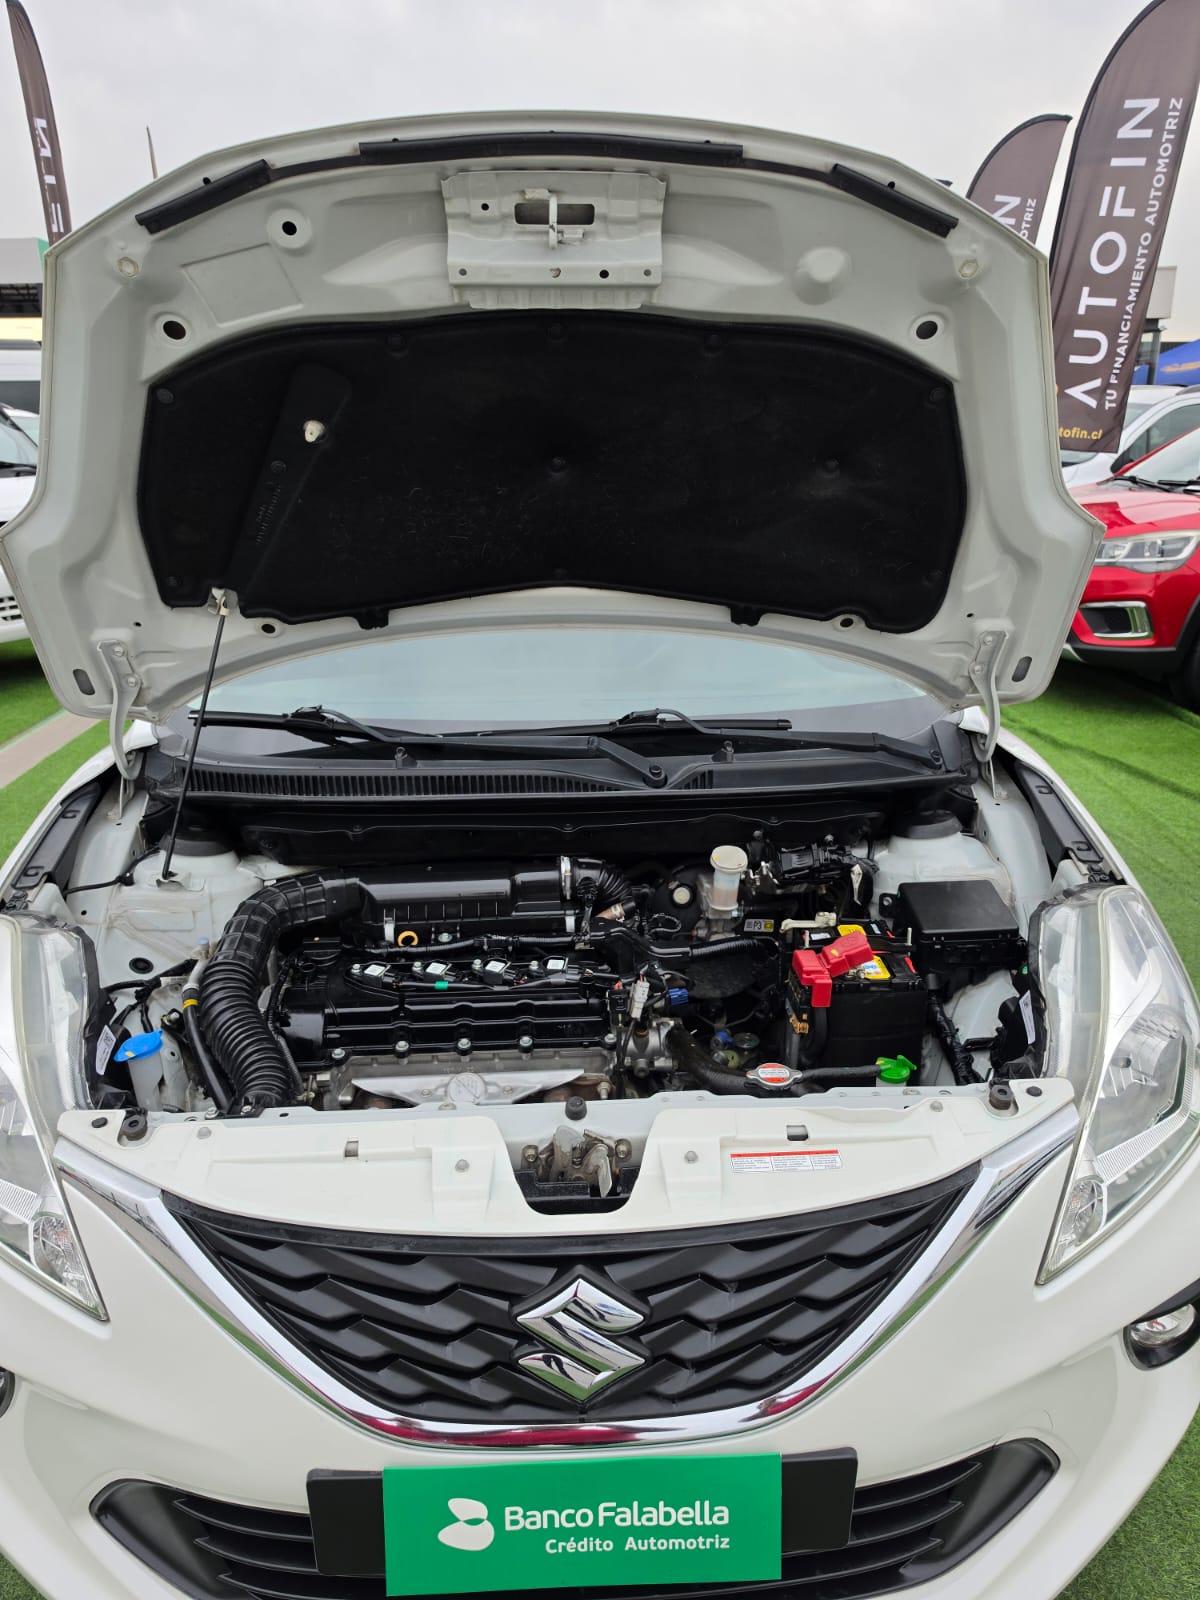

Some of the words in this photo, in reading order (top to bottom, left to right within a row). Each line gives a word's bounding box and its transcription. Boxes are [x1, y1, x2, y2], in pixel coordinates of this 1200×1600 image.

[1144, 97, 1183, 226] AUTOMOTRIZ
[1020, 198, 1037, 240] OTRIZ
[1064, 97, 1161, 410] AUTOFIN
[1110, 232, 1152, 384] FINANCIAMIENTO
[1105, 389, 1117, 410] TU
[1059, 426, 1103, 440] tofin.cl
[504, 1506, 594, 1531] Banco
[598, 1500, 729, 1527] Falabella
[545, 1537, 614, 1554] Crédito
[624, 1534, 730, 1551] Automotriz
